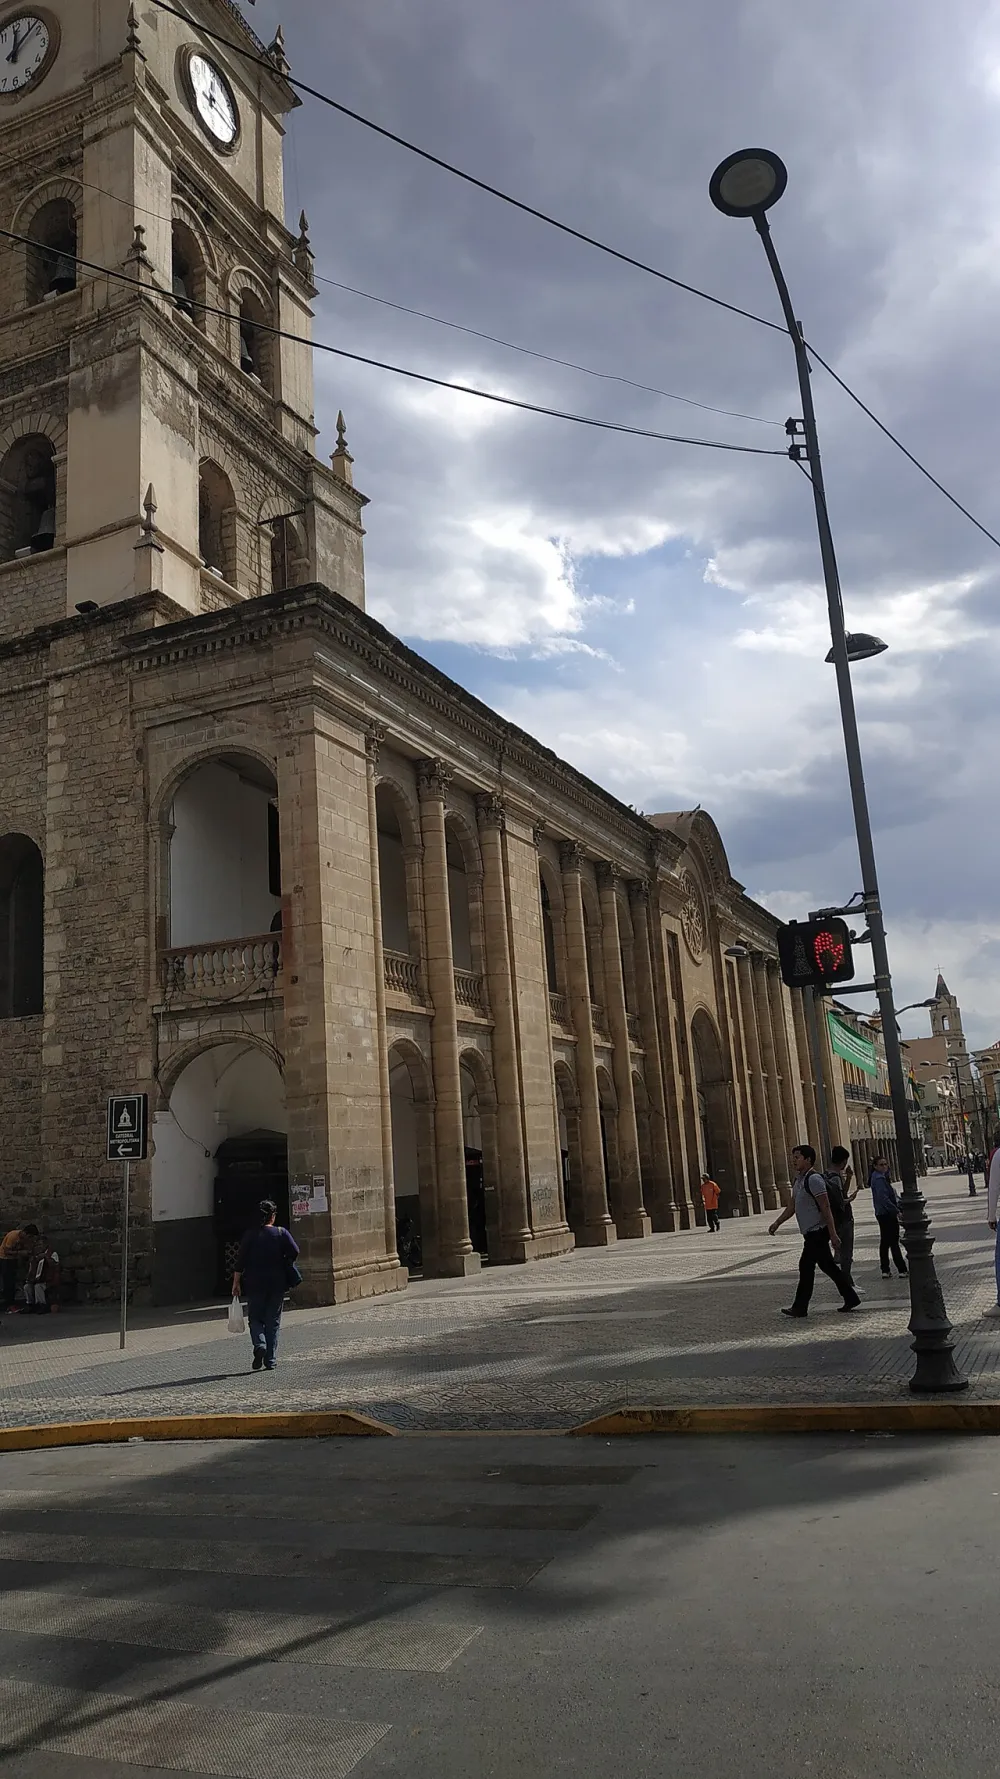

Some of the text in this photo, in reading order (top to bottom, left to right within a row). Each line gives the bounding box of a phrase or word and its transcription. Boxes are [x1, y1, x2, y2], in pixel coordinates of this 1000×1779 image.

[35, 25, 42, 36] 2
[0, 32, 7, 44] 11
[40, 38, 46, 48] 3
[34, 53, 41, 63] 4
[24, 66, 32, 78] 5
[1, 78, 8, 88] 7
[12, 76, 19, 87] 6
